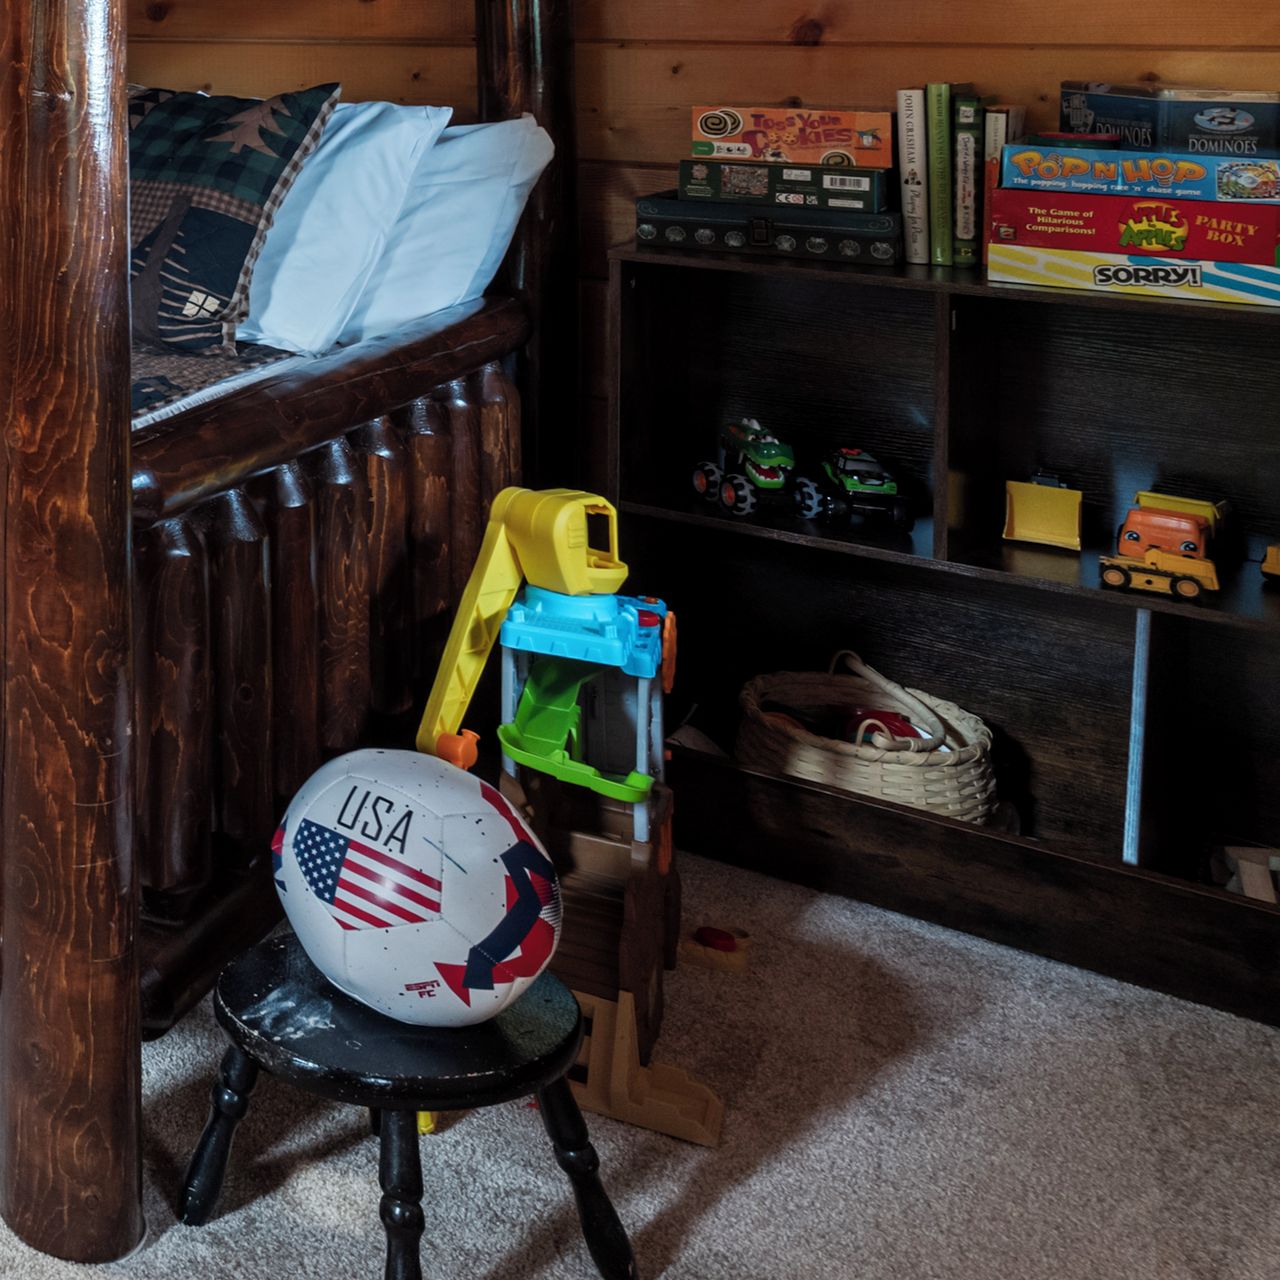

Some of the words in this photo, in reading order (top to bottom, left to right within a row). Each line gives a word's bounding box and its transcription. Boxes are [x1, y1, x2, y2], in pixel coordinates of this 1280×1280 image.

[904, 93, 914, 118] JOHN
[905, 120, 915, 164] GRISHAM
[1188, 138, 1257, 154] DOMINOES
[1010, 150, 1091, 179] POP
[1119, 157, 1208, 187] HOP
[1071, 180, 1107, 191] hopping
[1146, 185, 1172, 194] chase
[1028, 206, 1047, 215] The
[1049, 207, 1080, 217] Game
[1082, 209, 1094, 218] of
[1025, 223, 1096, 236] Comparisons!
[1036, 216, 1084, 226] Hilarious
[1194, 214, 1259, 236] PARTY
[1205, 230, 1246, 247] BOX
[1095, 265, 1202, 287] SORRY!
[336, 785, 413, 854] USA
[418, 989, 437, 999] FC
